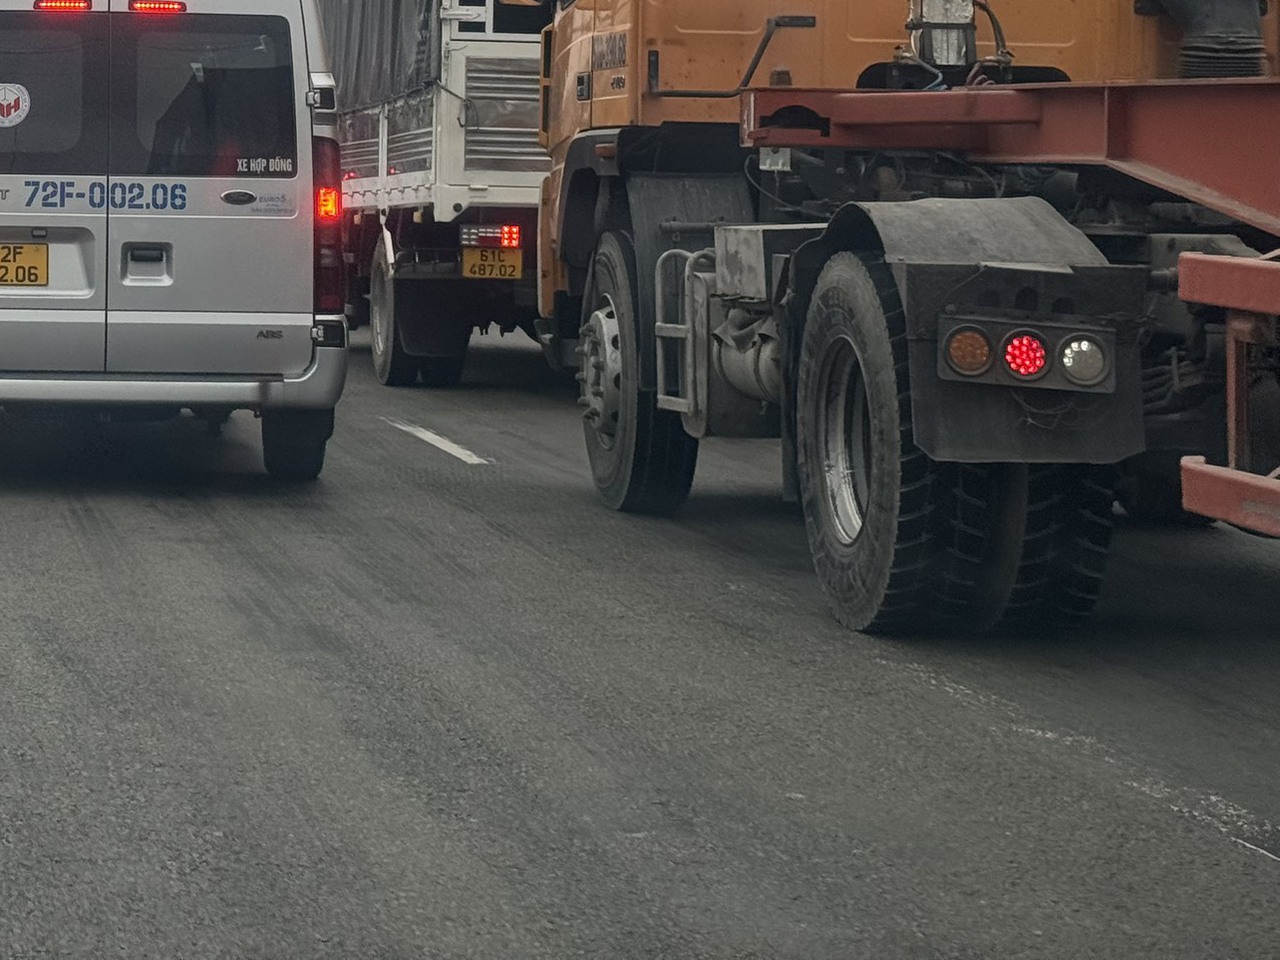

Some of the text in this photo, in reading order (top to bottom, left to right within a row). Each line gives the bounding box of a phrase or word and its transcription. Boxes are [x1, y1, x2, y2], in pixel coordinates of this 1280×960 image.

[236, 158, 248, 172] XE
[250, 157, 267, 174] HỢP
[24, 181, 187, 210] 72F-002.06
[480, 249, 506, 262] 61C
[470, 263, 516, 277] 487.02
